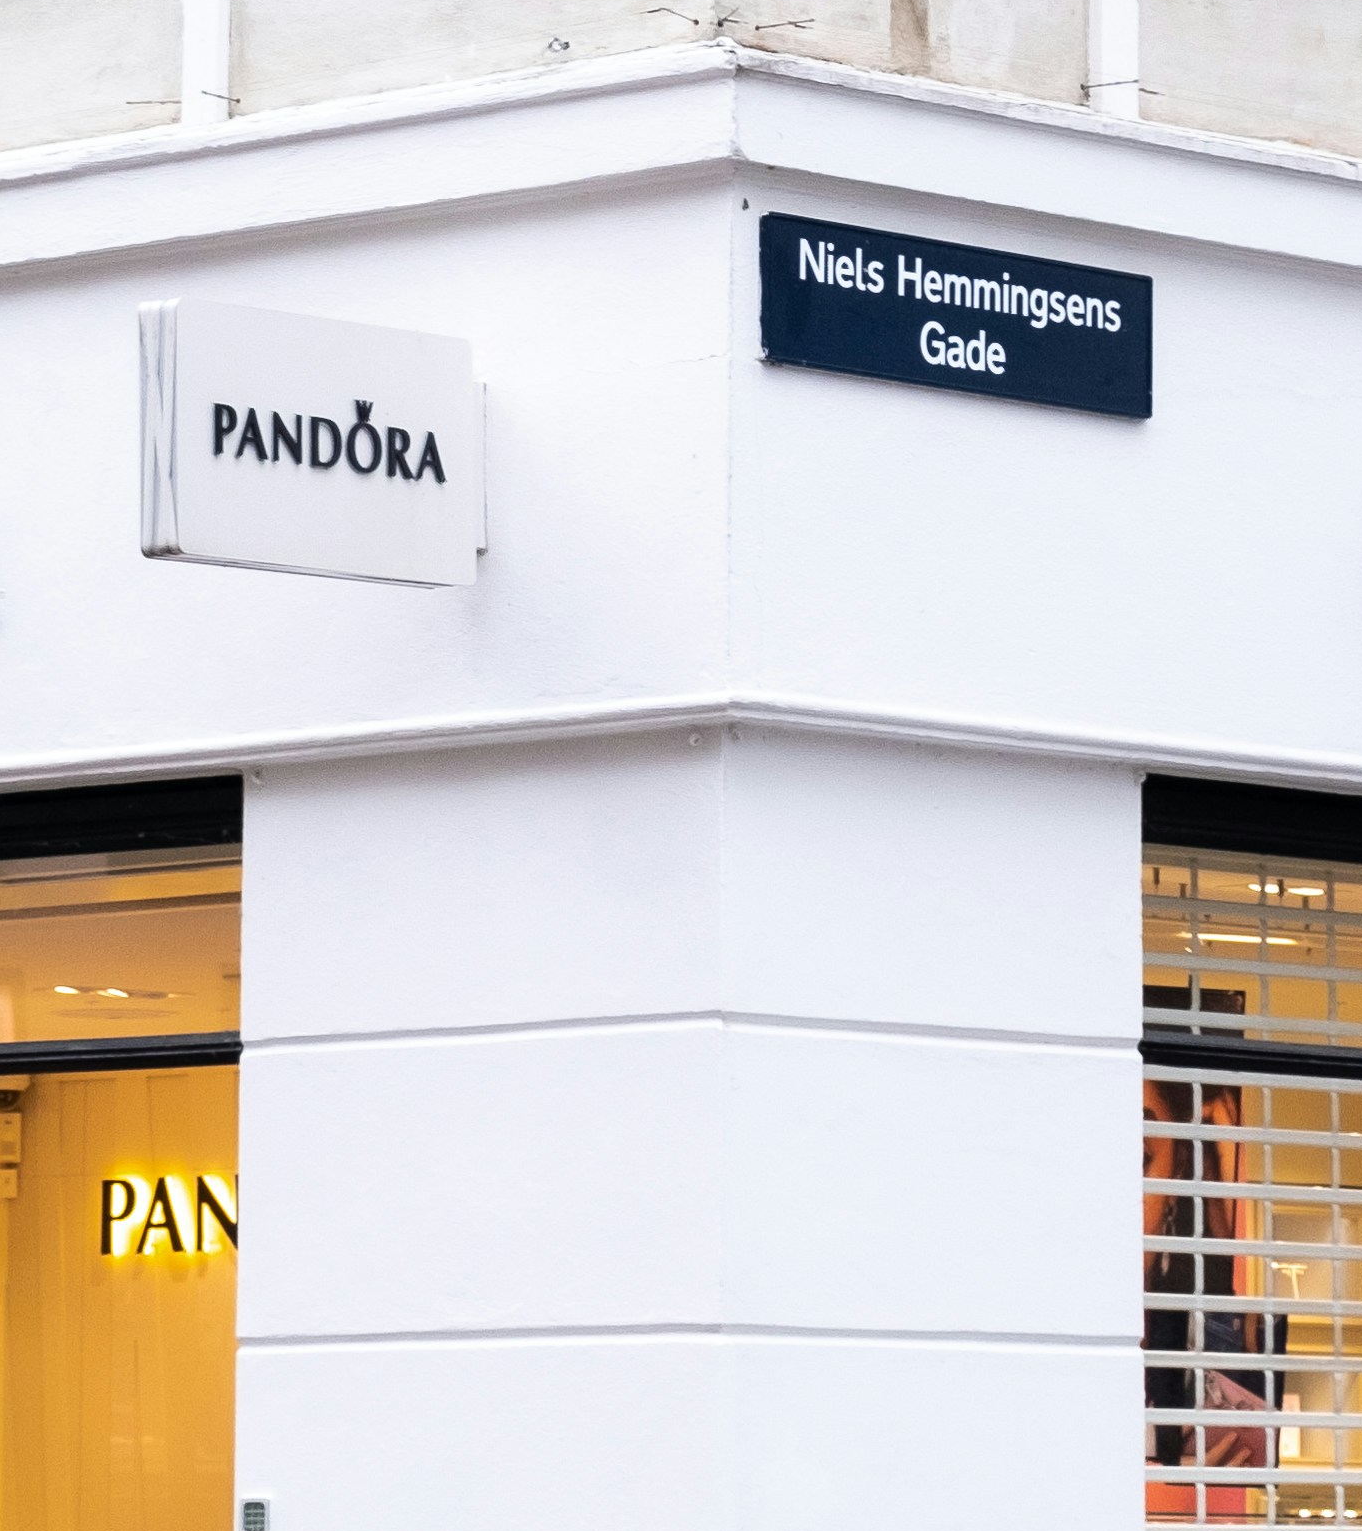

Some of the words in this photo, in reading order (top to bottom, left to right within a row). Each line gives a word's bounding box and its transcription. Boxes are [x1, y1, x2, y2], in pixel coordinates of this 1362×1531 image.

[799, 237, 885, 294] Niels
[897, 254, 1122, 333] Hemmingsens
[920, 320, 1007, 375] Gade
[212, 401, 447, 485] PANDORA
